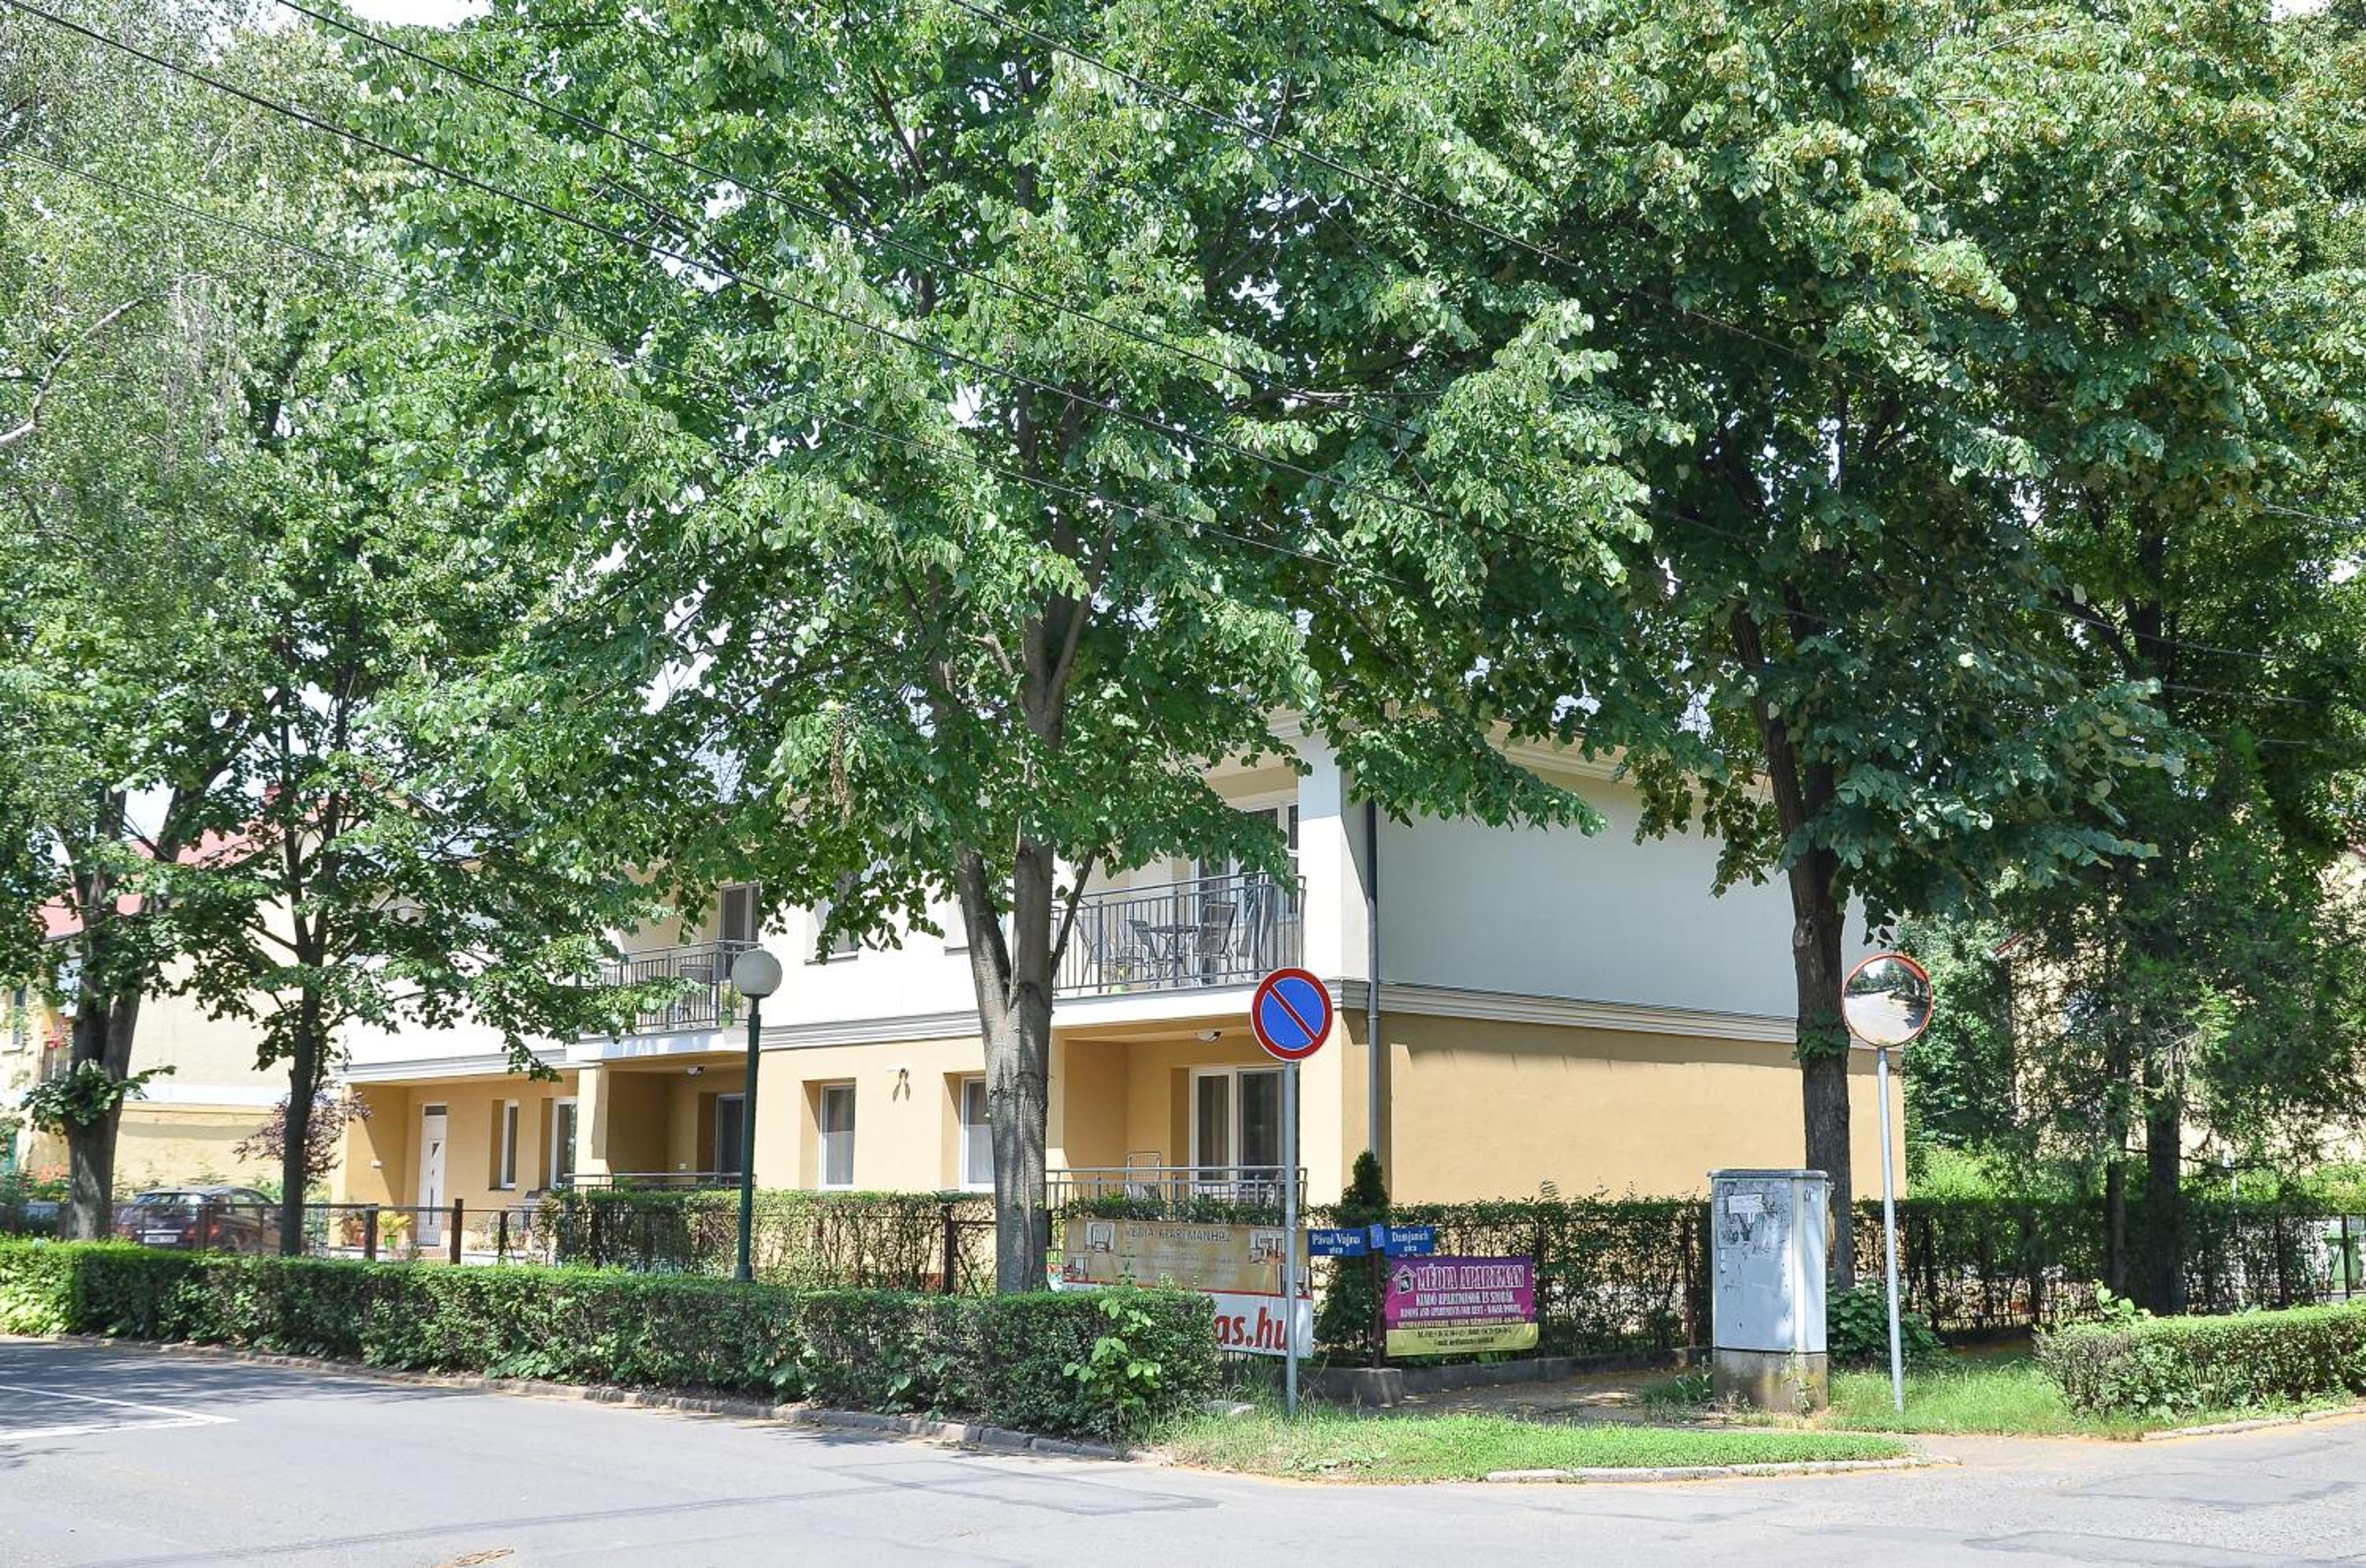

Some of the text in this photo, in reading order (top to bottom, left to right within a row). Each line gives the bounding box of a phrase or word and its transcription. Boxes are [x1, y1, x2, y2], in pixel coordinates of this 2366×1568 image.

[1336, 1233, 1360, 1247] Vajna
[1392, 1230, 1429, 1245] Damjanich
[1416, 1263, 1524, 1291] MÉDIA APARTMAN
